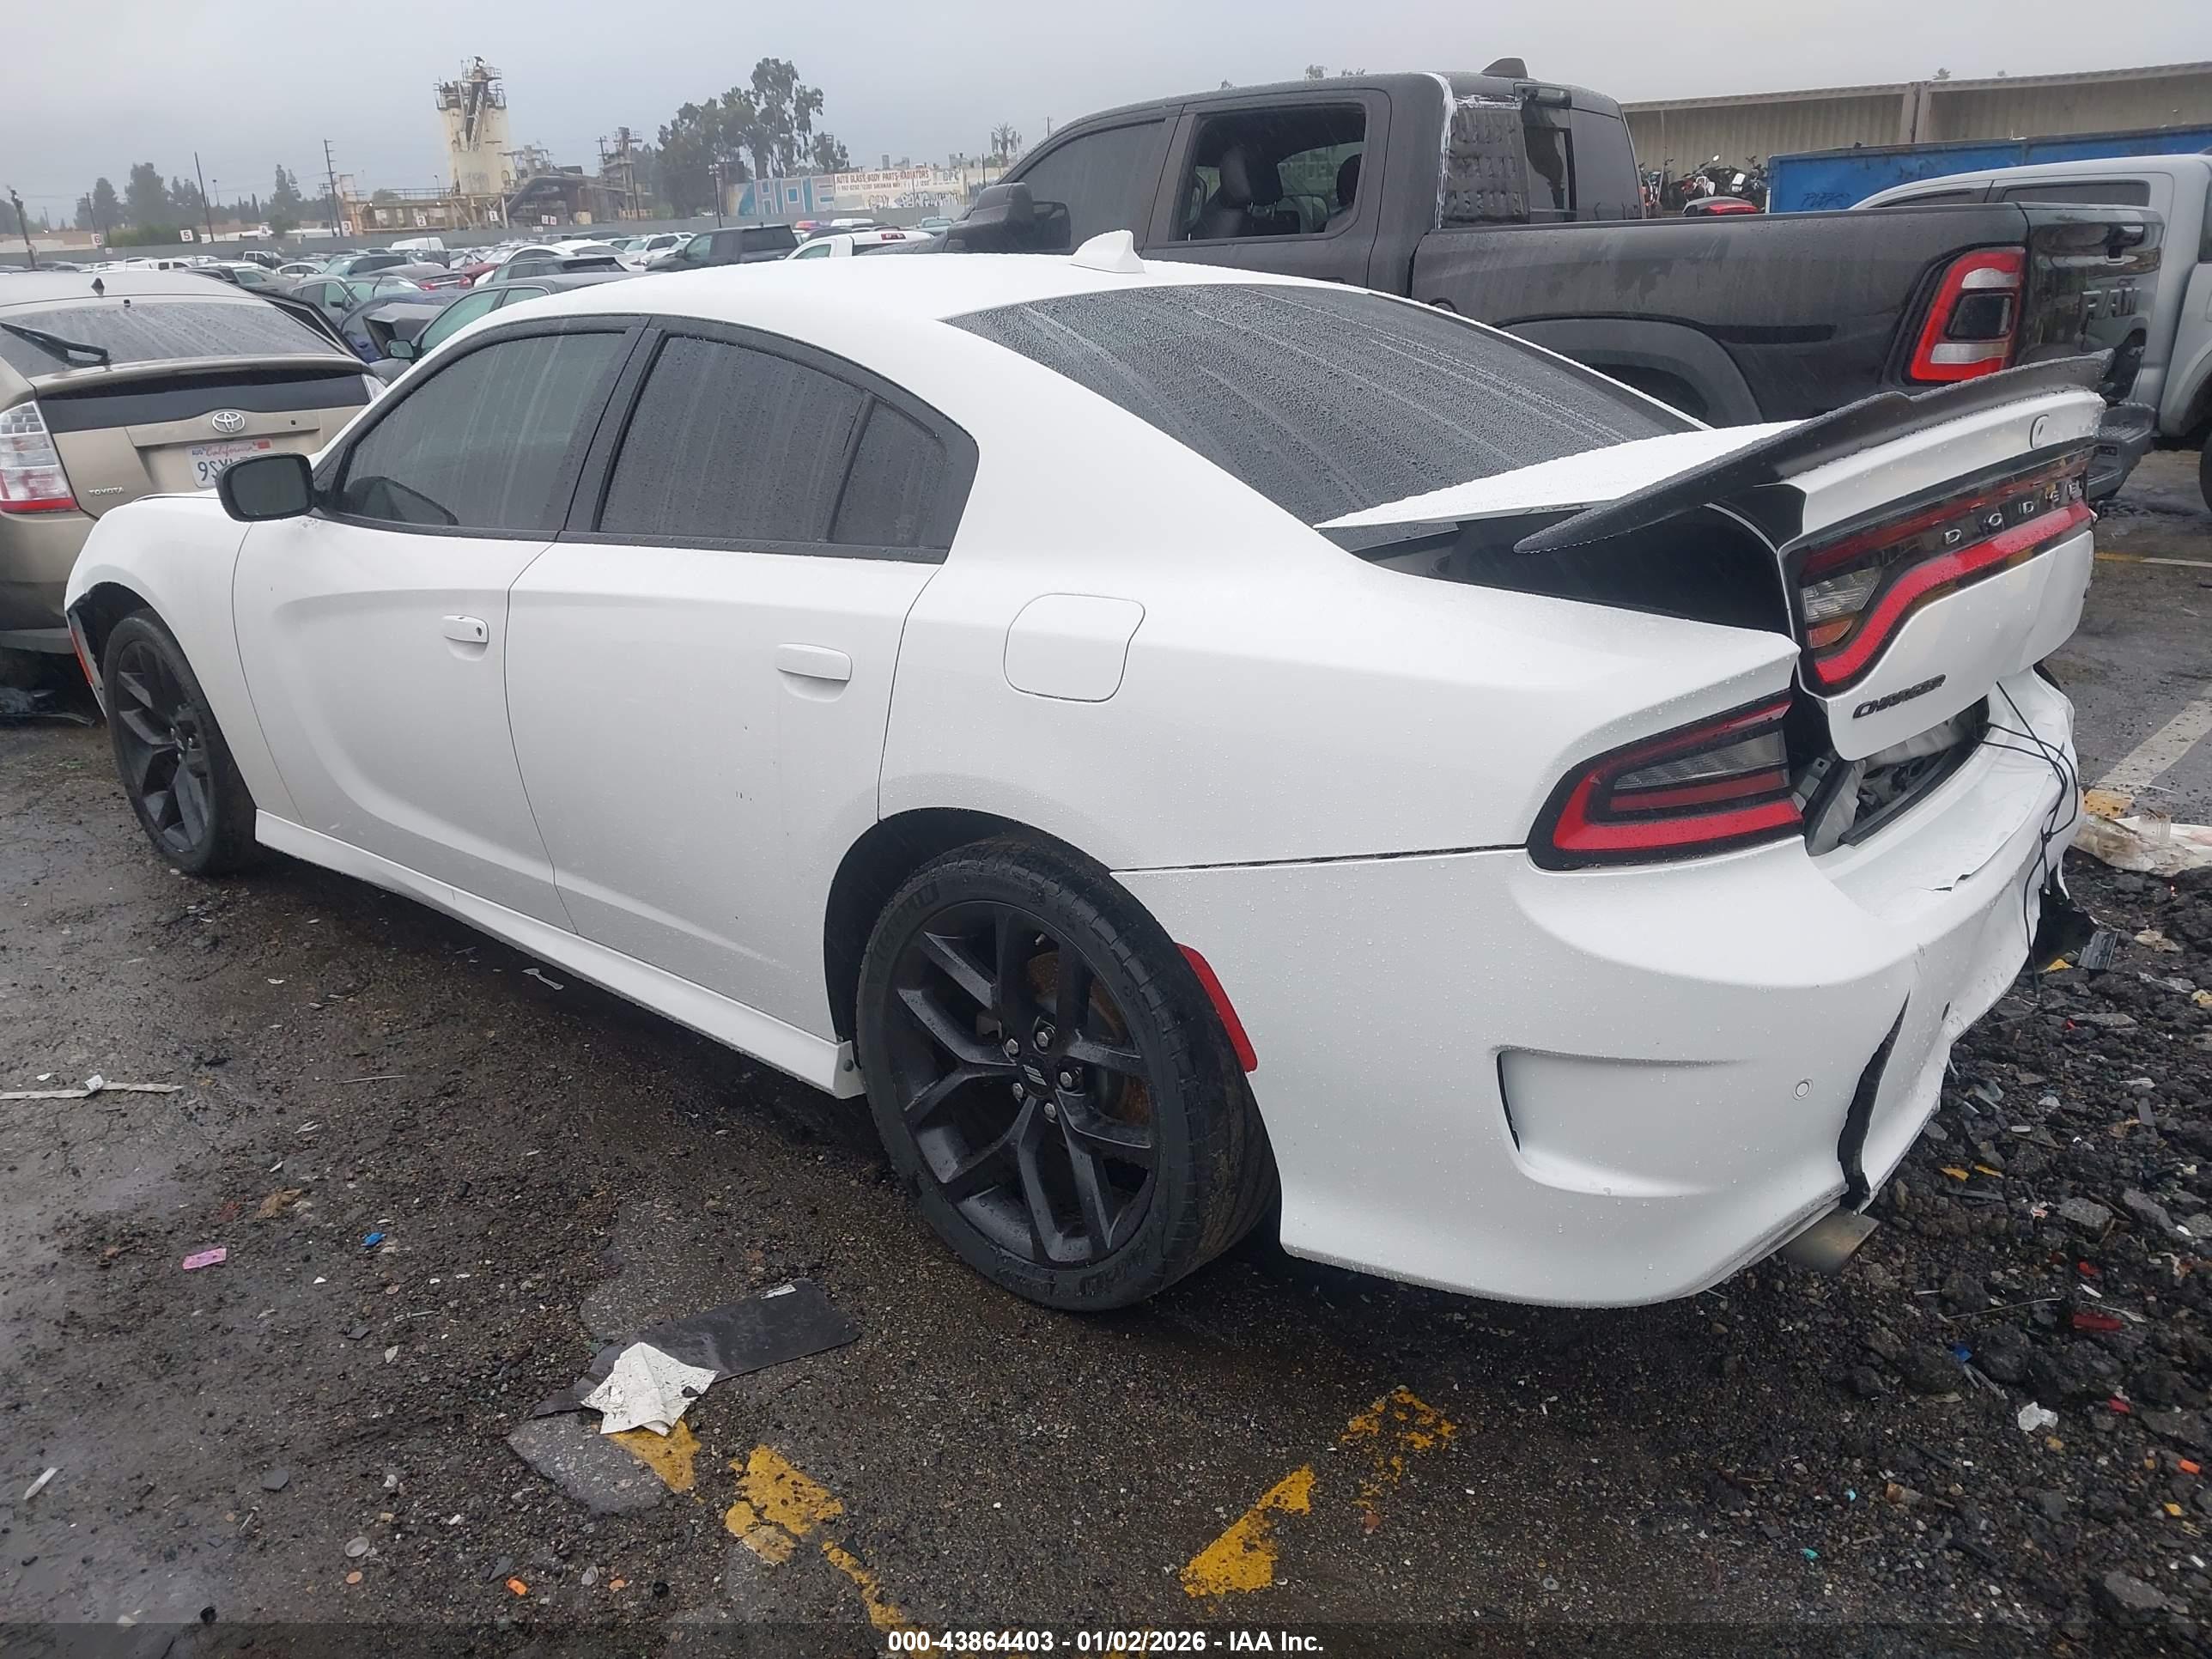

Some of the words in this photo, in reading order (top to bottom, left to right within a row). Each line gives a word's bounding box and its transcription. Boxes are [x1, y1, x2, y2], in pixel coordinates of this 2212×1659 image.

[836, 175, 849, 184] AUTO
[883, 172, 898, 181] PARTS
[2081, 287, 2139, 318] RAM
[88, 486, 125, 496] TOYOTA
[1944, 483, 2078, 544] DODGE
[1852, 673, 1947, 720] CHARGER
